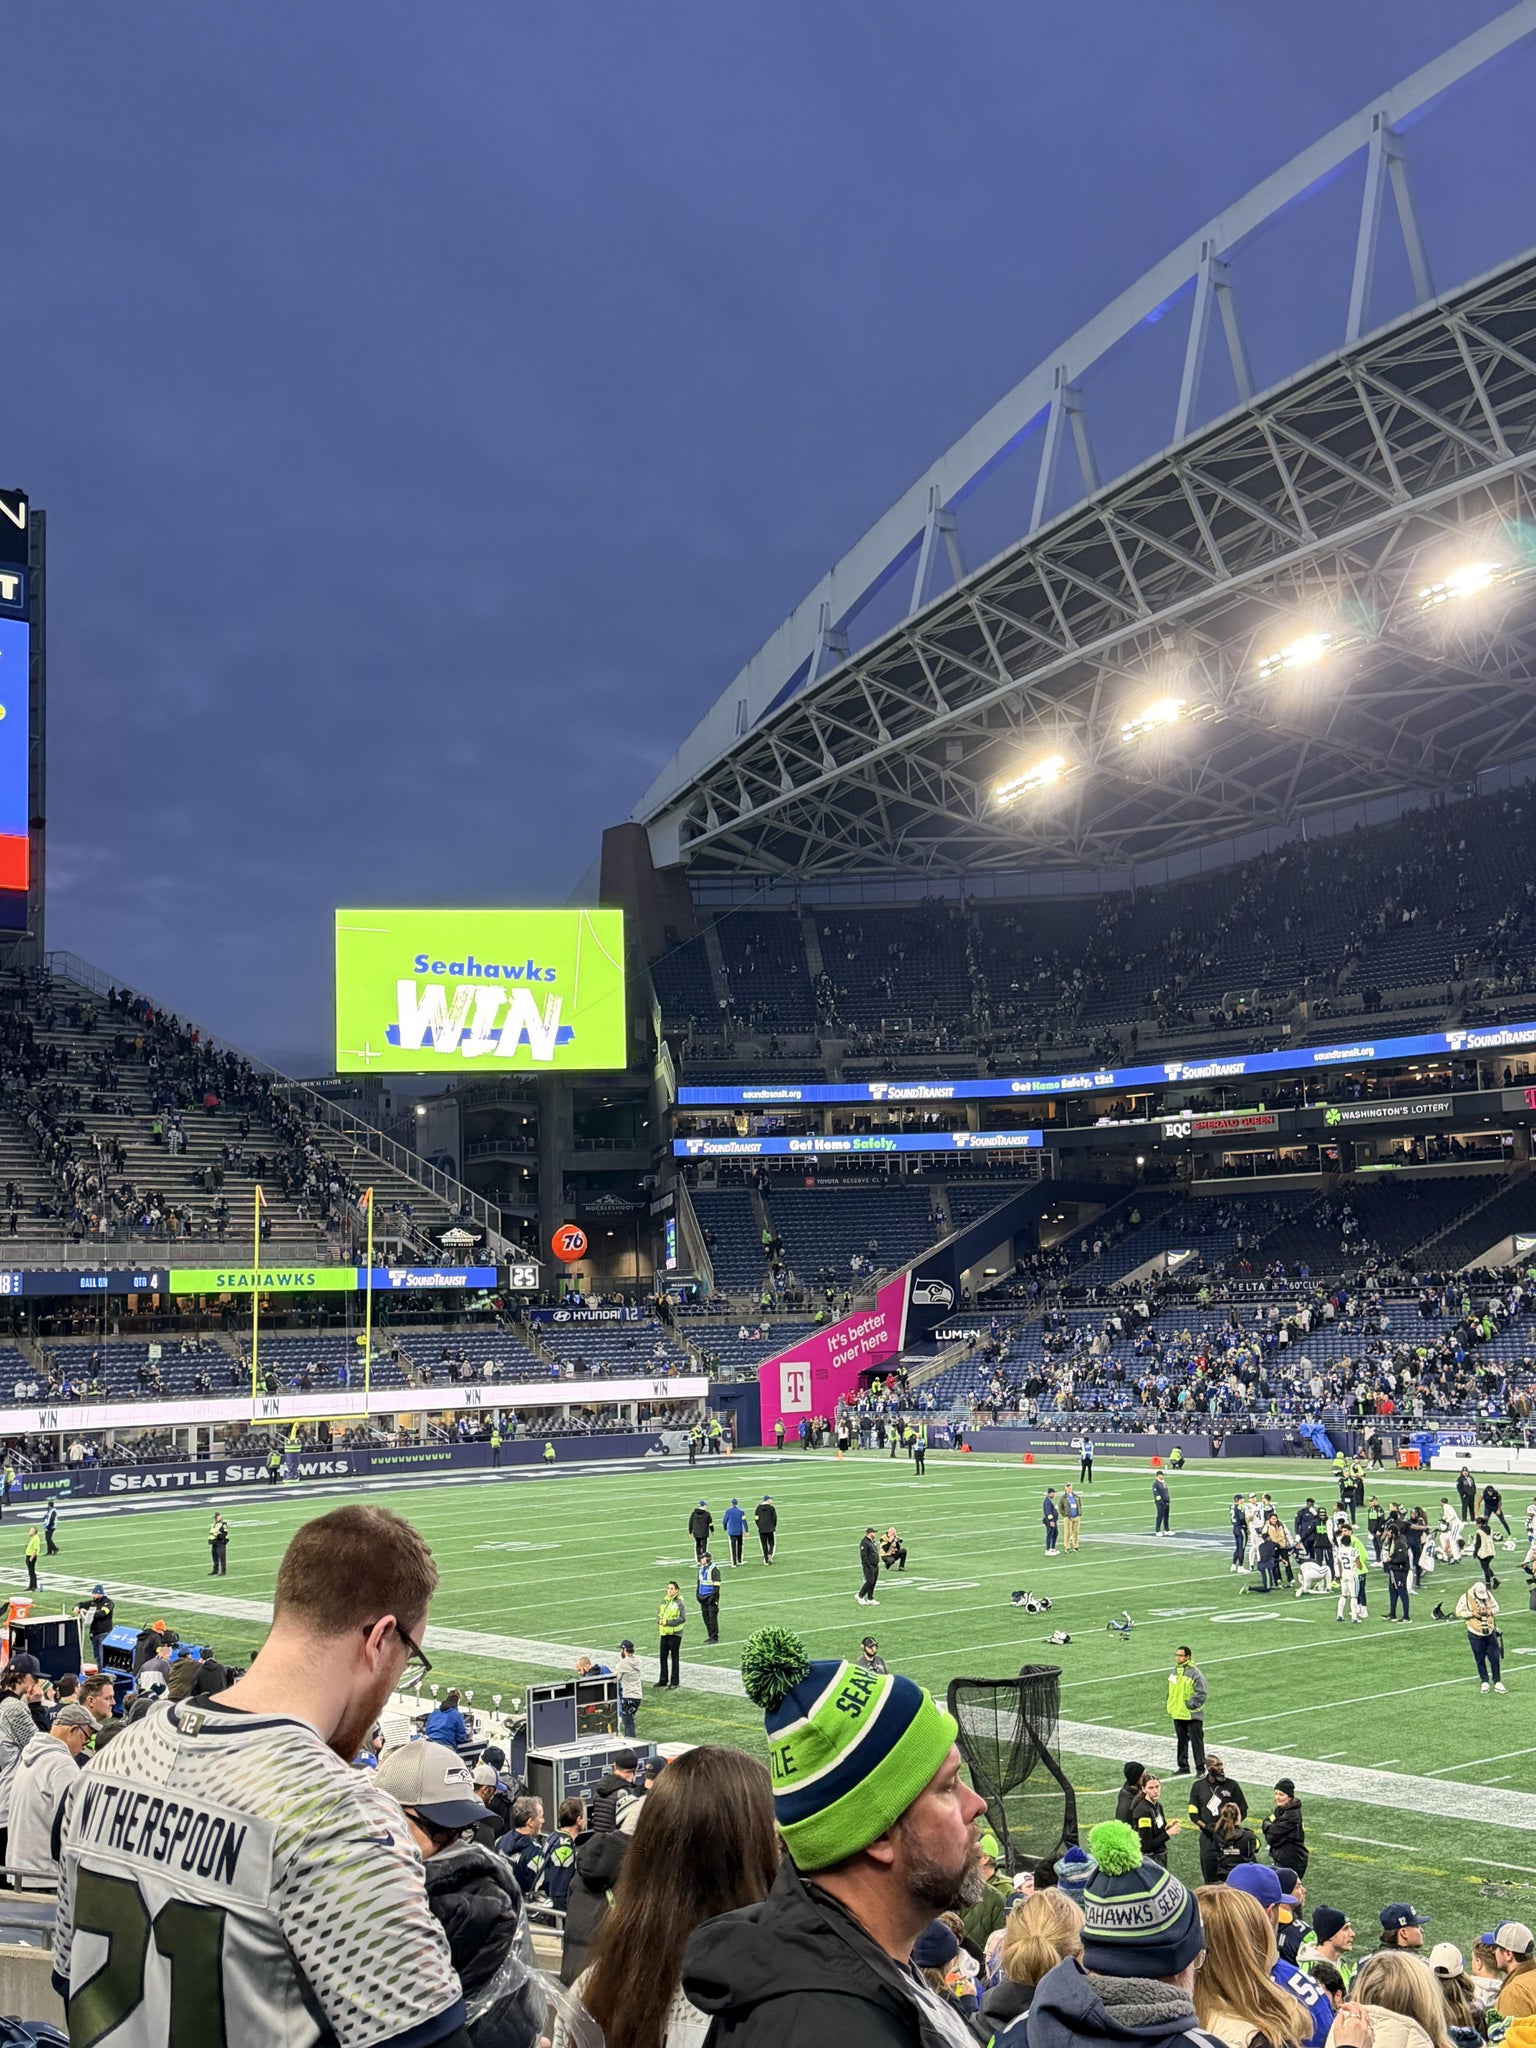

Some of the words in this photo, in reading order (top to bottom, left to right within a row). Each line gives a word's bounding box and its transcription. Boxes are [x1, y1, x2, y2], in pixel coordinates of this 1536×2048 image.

[414, 954, 557, 982] Seahawks
[396, 980, 563, 1061] WIN
[1314, 1047, 1375, 1061] soundtransit.org
[743, 1090, 801, 1100] soundtransit.org
[1341, 1107, 1409, 1120] WASHINGTON'S
[1411, 1103, 1450, 1114] LOTTERY
[1165, 1122, 1191, 1138] EQC
[789, 1140, 813, 1151] Get
[814, 1140, 851, 1150] Home
[852, 1137, 897, 1151] Safely,
[562, 1233, 584, 1251] 76
[150, 1274, 158, 1289] 4
[216, 1274, 316, 1287] SEAHAWKS
[513, 1268, 535, 1286] 25
[573, 1310, 620, 1320] HYUNDAI
[625, 1308, 639, 1320] 12
[826, 1333, 848, 1353] It's
[848, 1312, 887, 1341] better
[832, 1345, 860, 1368] over
[861, 1330, 888, 1353] here
[652, 1380, 669, 1396] WIN
[464, 1389, 481, 1405] WIN
[262, 1399, 280, 1416] WIN
[38, 1410, 58, 1429] WIN
[183, 1713, 198, 1733] 12
[79, 1781, 248, 1885] WITHERSPOON
[69, 1866, 228, 2048] 21
